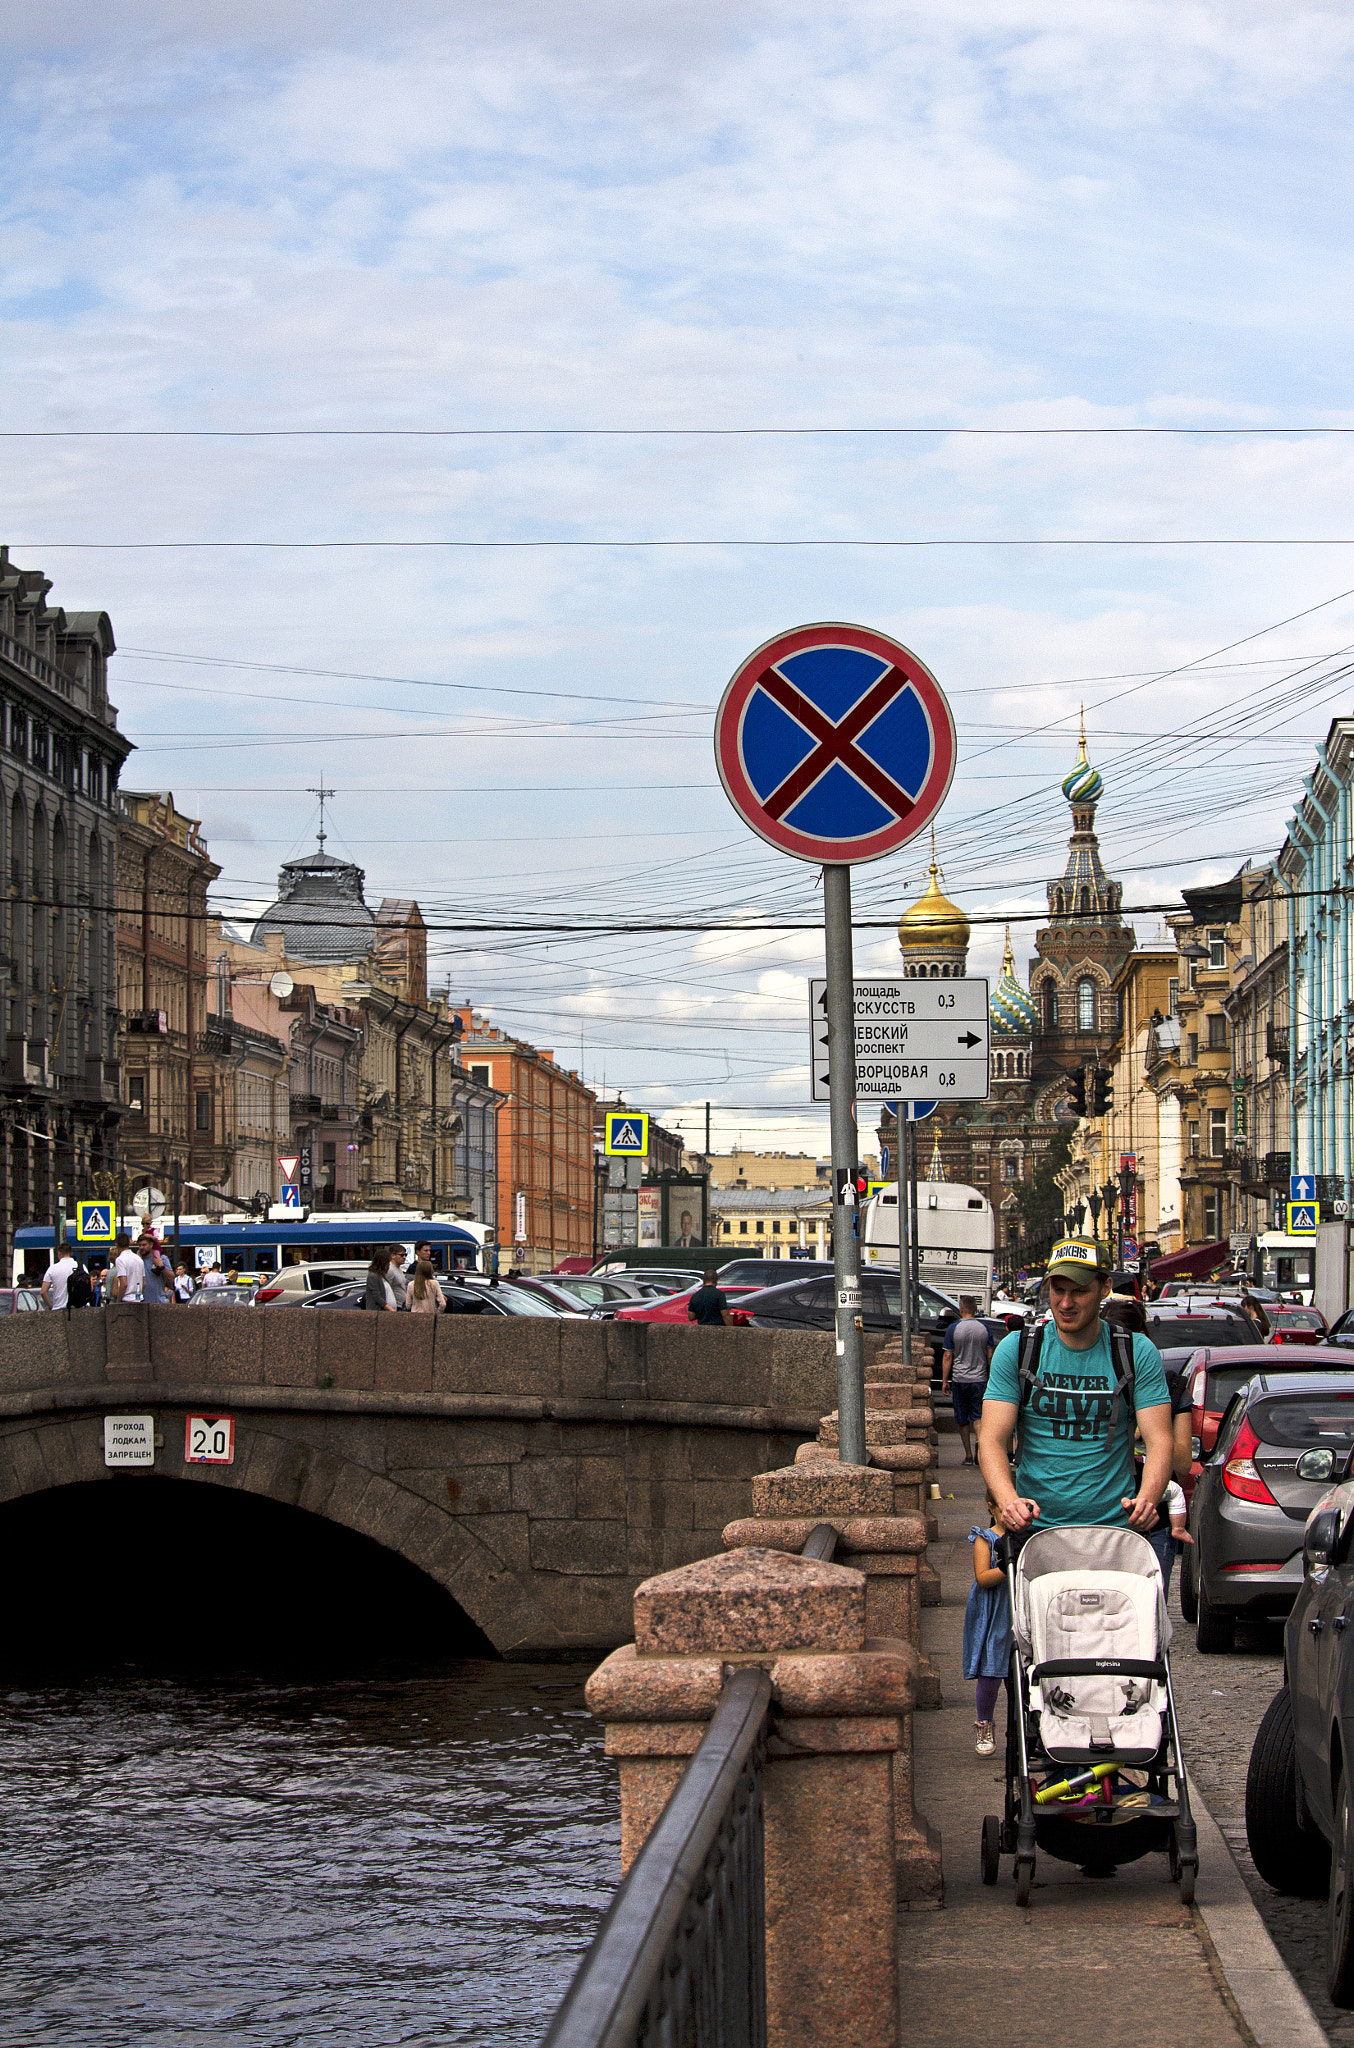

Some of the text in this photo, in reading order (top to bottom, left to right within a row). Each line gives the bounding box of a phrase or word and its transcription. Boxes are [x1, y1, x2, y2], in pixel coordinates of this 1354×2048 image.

[854, 988, 900, 998] лощадь
[938, 995, 955, 1010] 0,3
[854, 1024, 908, 1039] ЕВСКИЙ
[856, 1043, 905, 1056] роспект
[855, 1065, 928, 1080] ВОРЦОВАЯ
[939, 1073, 956, 1087] 0,8
[856, 1082, 902, 1094] лощадь
[1236, 1097, 1244, 1135] ЧАЙКА
[302, 1148, 310, 1185] КОФЕ
[946, 1250, 958, 1260] 78
[1055, 1245, 1088, 1260] PACKERS
[1042, 1372, 1110, 1391] NEVER
[1032, 1388, 1114, 1420] GIVE
[113, 1423, 145, 1431] ПРОХОД
[1050, 1418, 1101, 1441] UP!
[112, 1437, 147, 1445] ЛОДКАМ
[193, 1430, 226, 1454] 2.0
[108, 1451, 152, 1459] ЗАПРЕЩЕН
